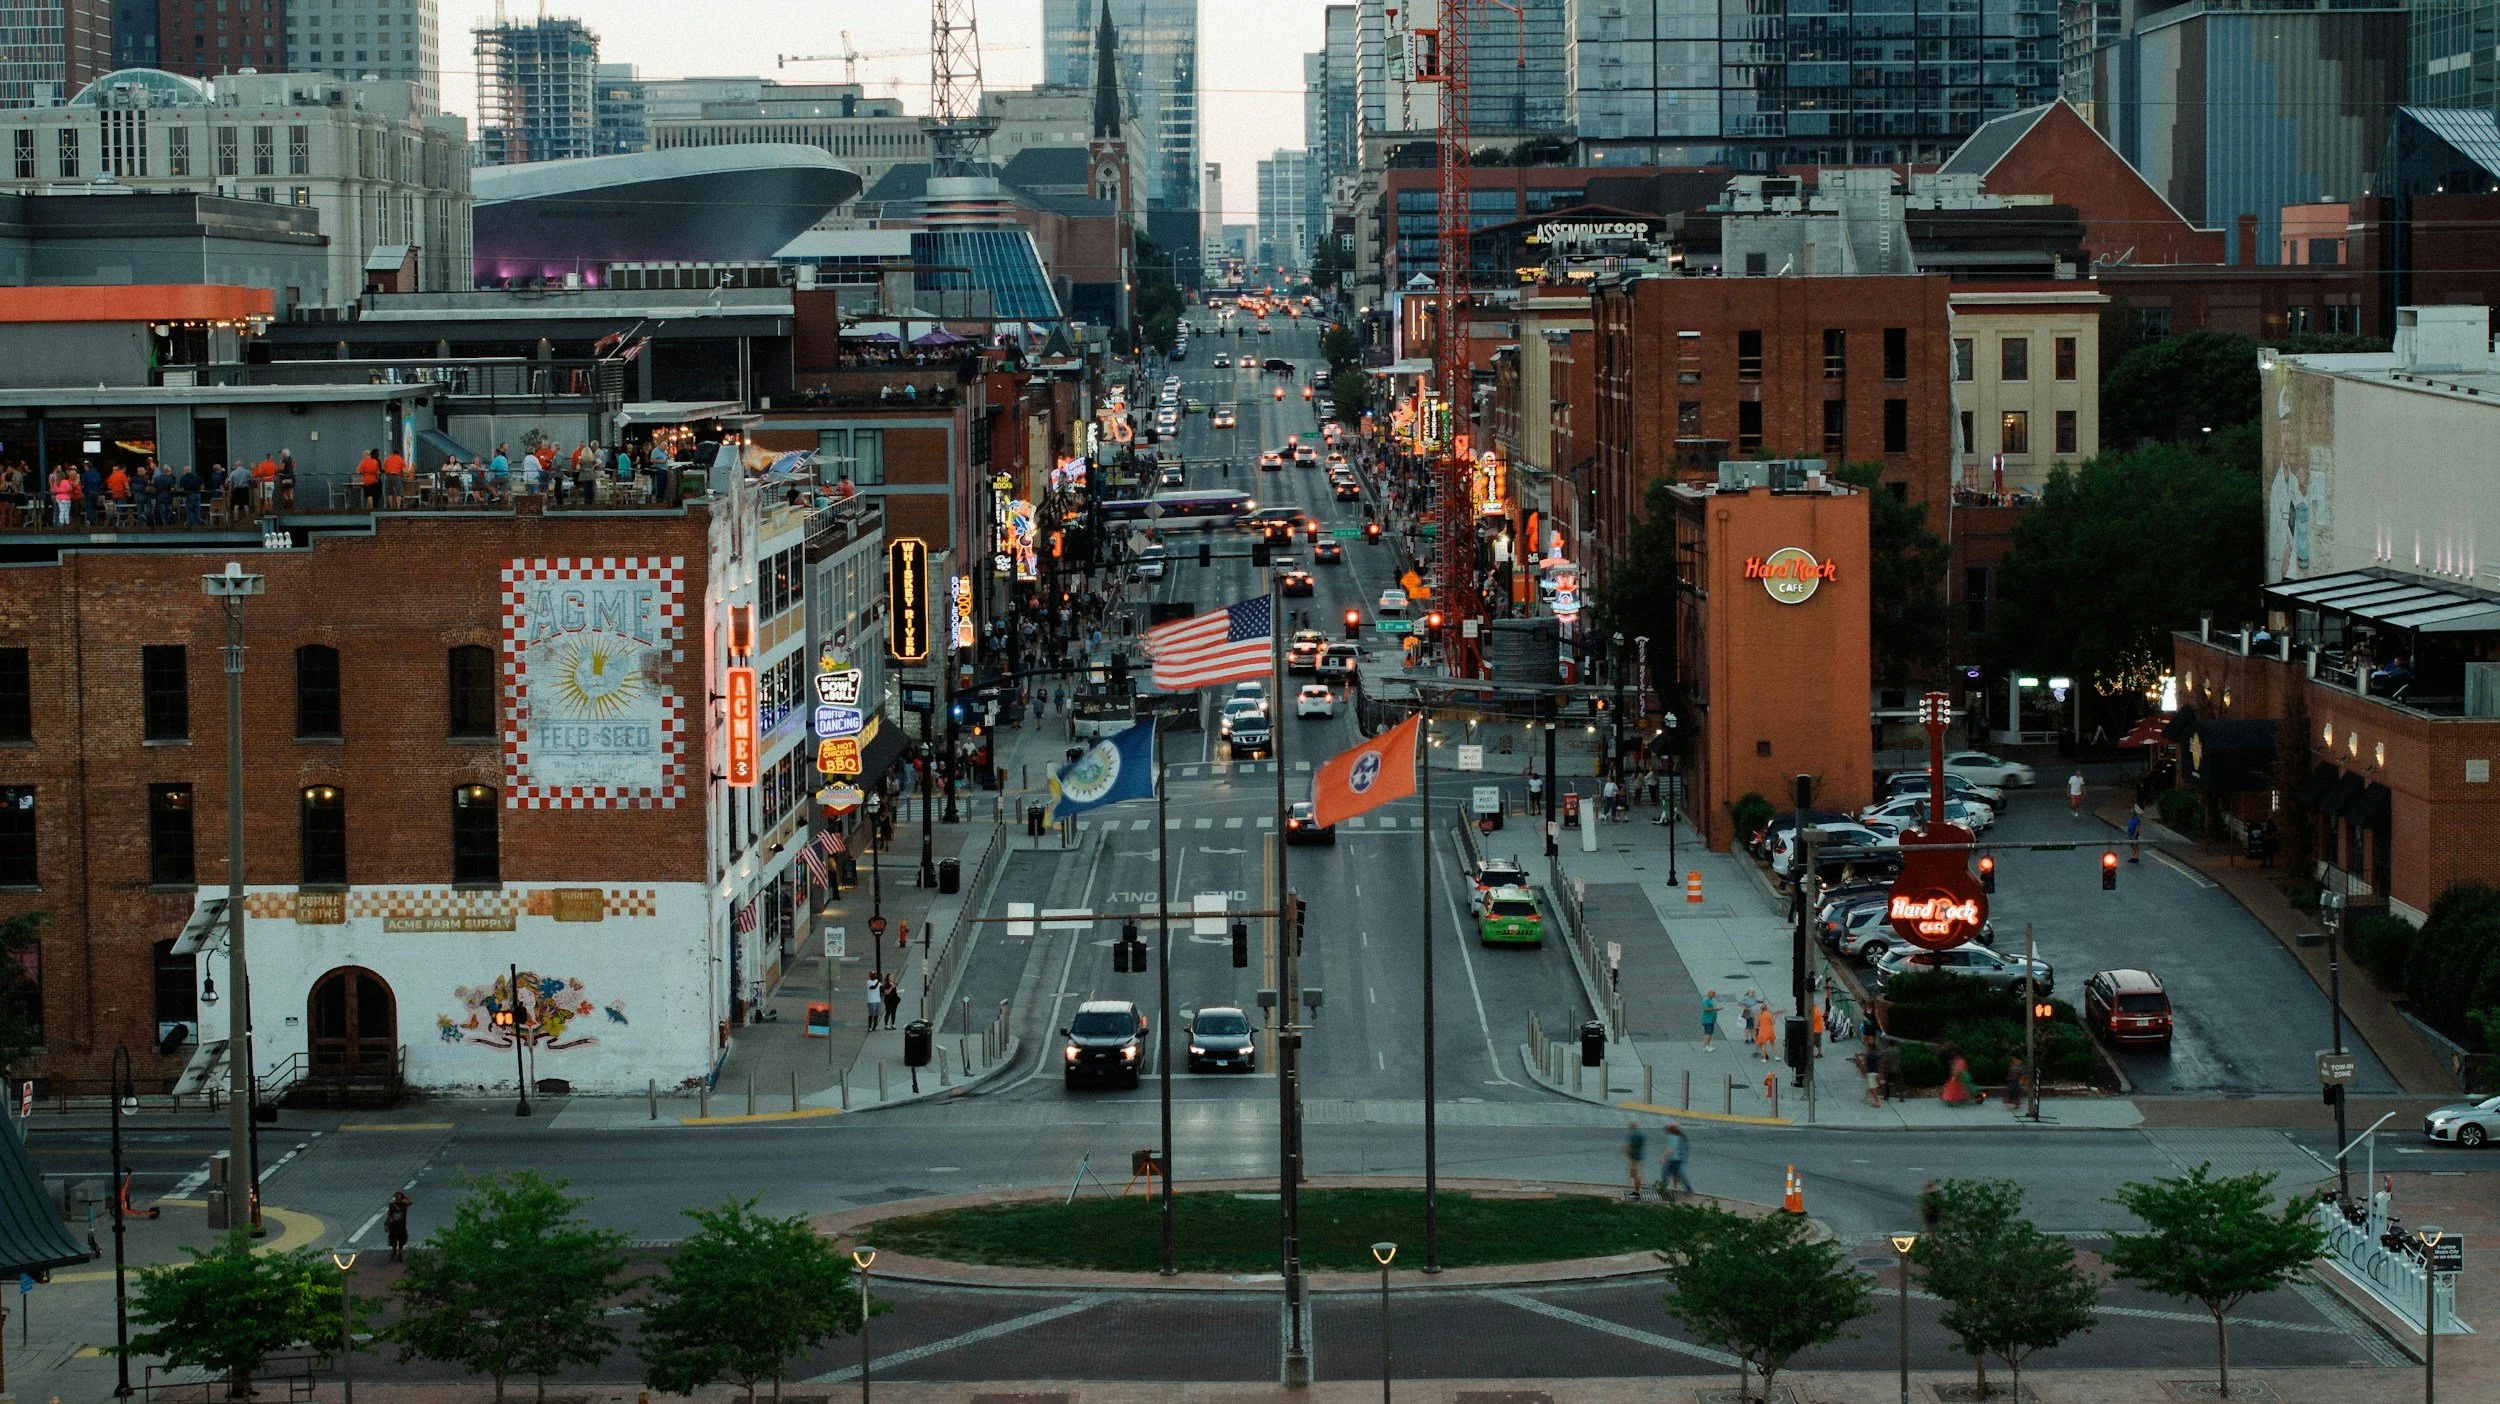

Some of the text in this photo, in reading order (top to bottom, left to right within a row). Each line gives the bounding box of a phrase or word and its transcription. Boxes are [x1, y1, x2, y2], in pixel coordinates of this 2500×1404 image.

[1603, 222, 1649, 234] FOOD
[1745, 556, 1836, 582] Hard Rock
[1779, 583, 1804, 593] CAFE
[901, 542, 915, 656] WHISKEY RIVER
[531, 589, 654, 645] ACME
[951, 576, 959, 647] BOOTLEGGERS
[820, 680, 856, 693] BOWL
[734, 675, 750, 760] ACME
[820, 710, 847, 720] ROOFTOP
[820, 716, 859, 733] DANCING
[540, 726, 589, 749] FEED
[601, 725, 651, 749] SEED
[837, 741, 854, 750] HOT
[822, 748, 856, 758] CHICKEN
[825, 758, 857, 771] BBQ
[300, 896, 341, 907] PURINA
[1106, 892, 1158, 902] ONLY
[300, 909, 340, 919] CHOWS
[1890, 896, 1978, 925] Hard Rock
[388, 919, 513, 929] ACME FARM SUPPLY
[1919, 921, 1949, 935] CAFE
